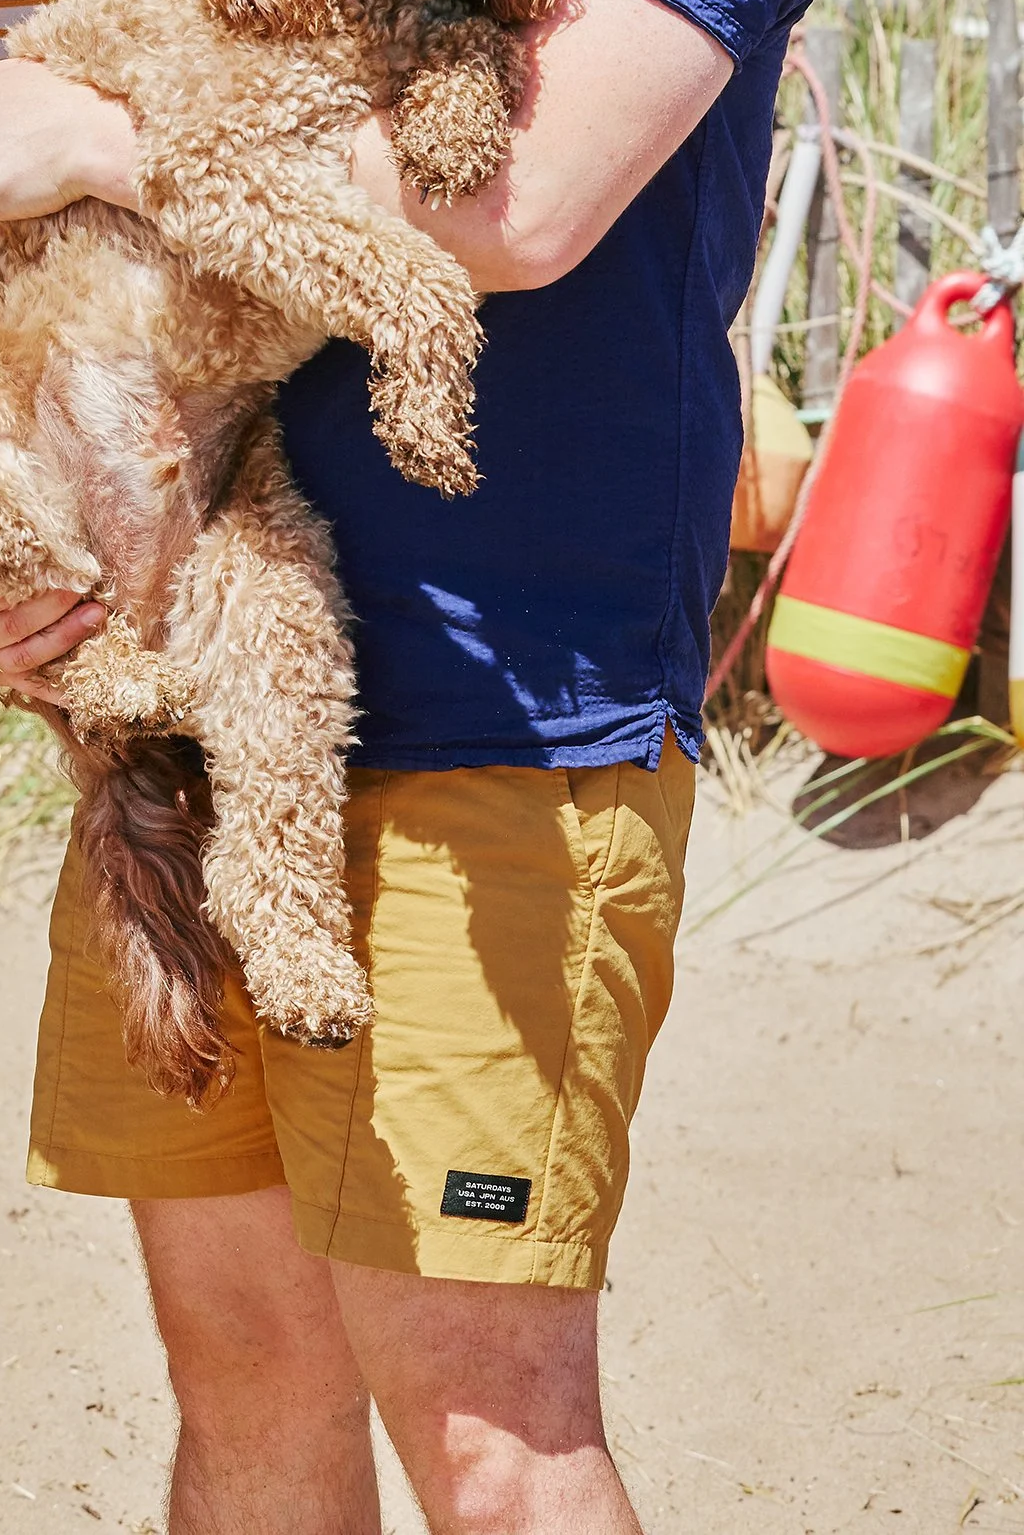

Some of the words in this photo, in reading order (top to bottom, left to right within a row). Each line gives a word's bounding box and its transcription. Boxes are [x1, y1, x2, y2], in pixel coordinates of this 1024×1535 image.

[465, 1182, 512, 1193] SATURDAYS
[458, 1190, 475, 1198] USA
[479, 1193, 496, 1201] JPN
[499, 1195, 515, 1203] AUS
[465, 1200, 483, 1208] EST.
